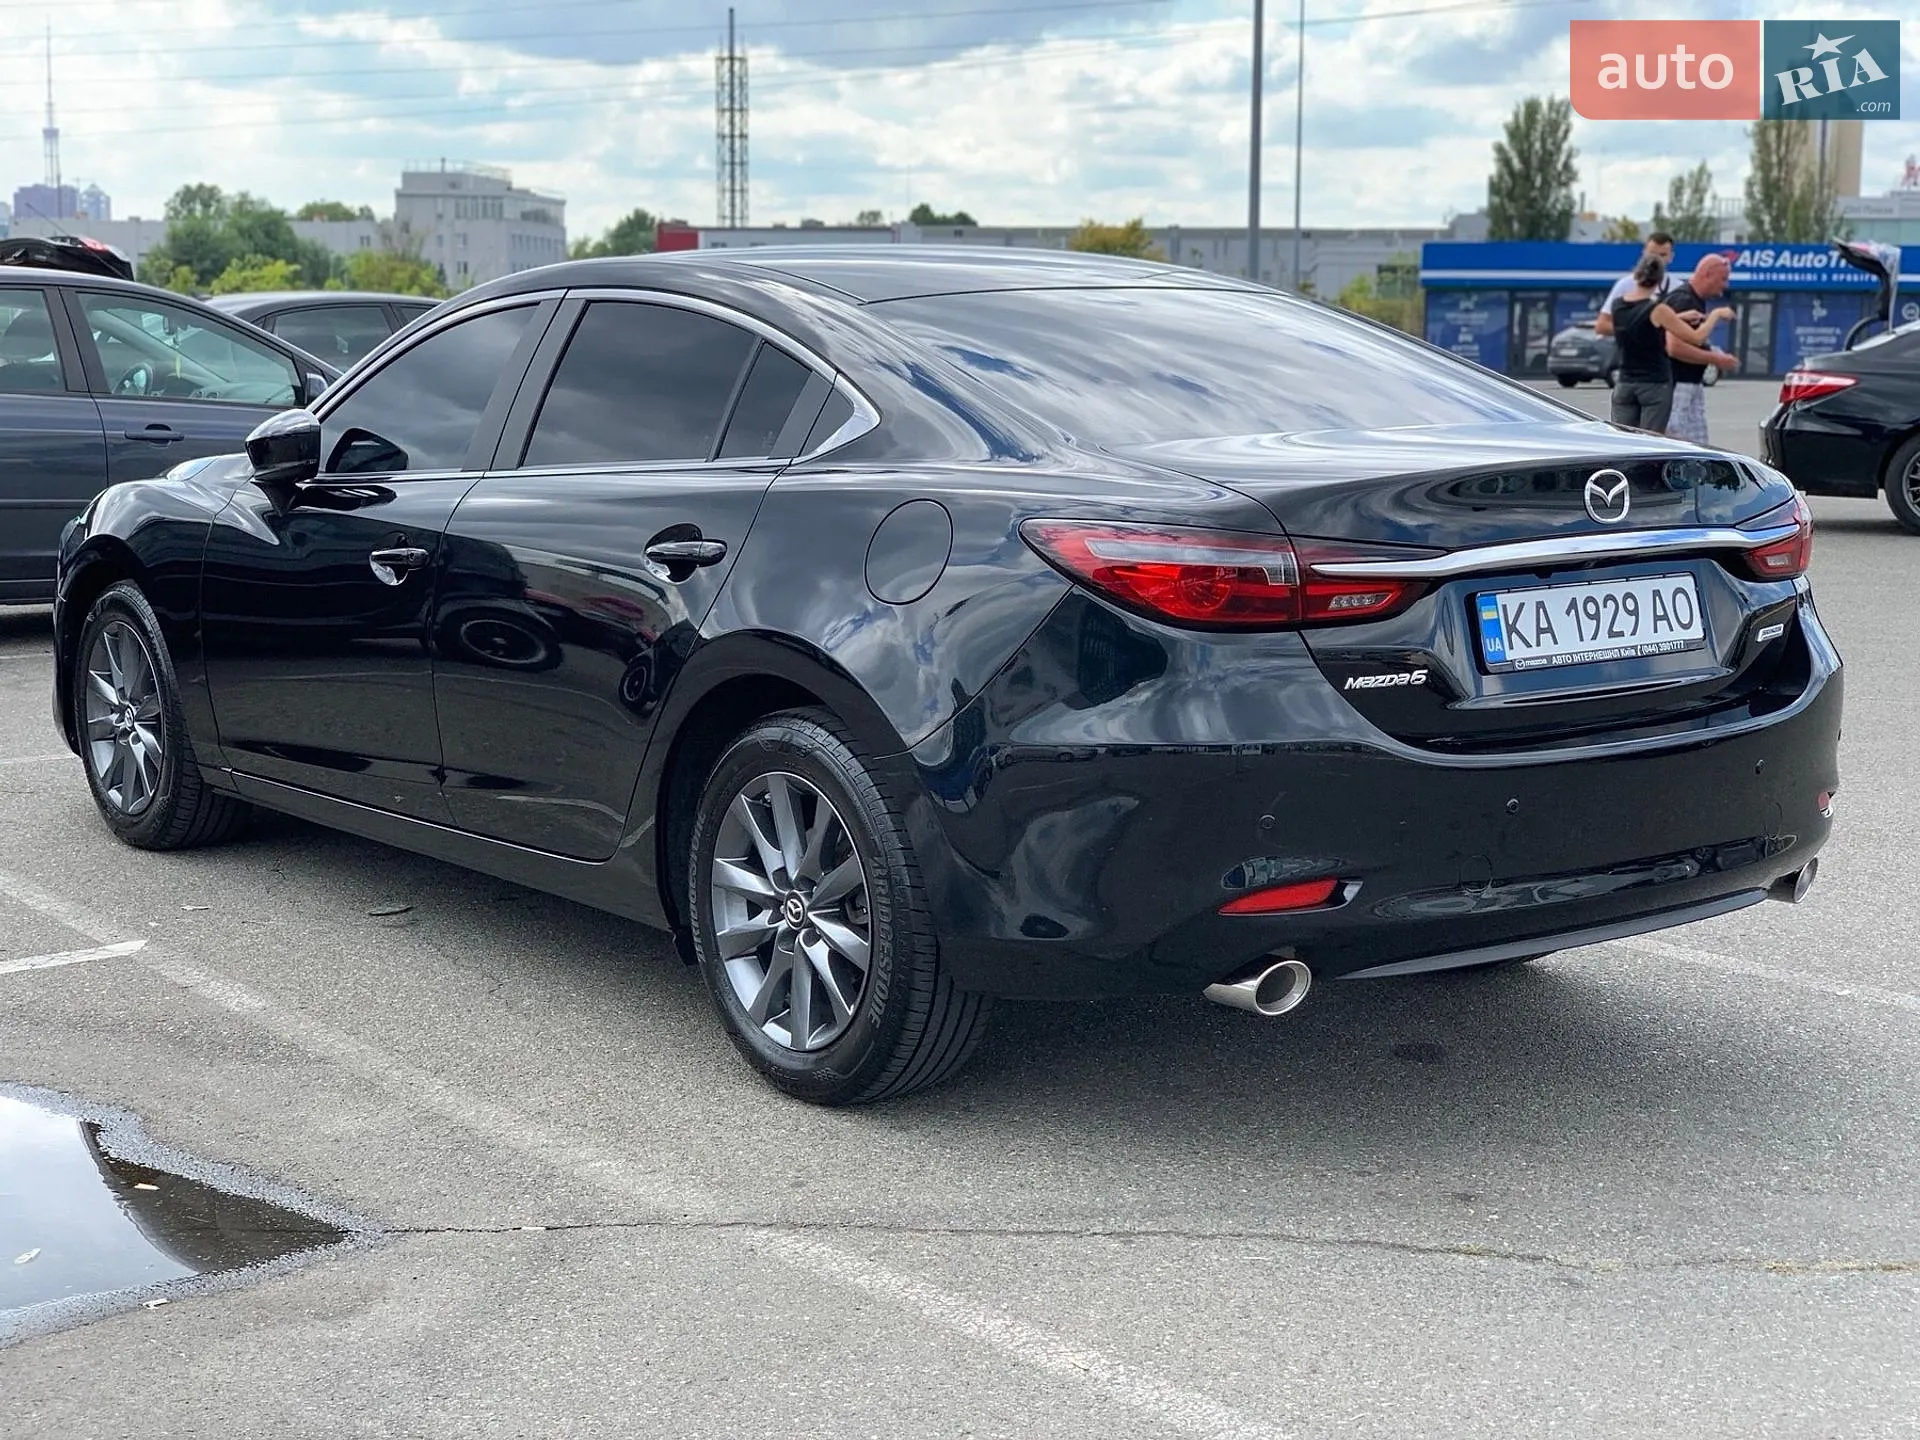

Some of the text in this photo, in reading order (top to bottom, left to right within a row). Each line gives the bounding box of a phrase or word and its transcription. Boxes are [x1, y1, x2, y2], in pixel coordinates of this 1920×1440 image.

[1735, 250, 1853, 268] AIS AutoTr
[1502, 587, 1694, 650] KA 1929 AO
[1487, 639, 1503, 652] UA
[1552, 653, 1572, 665] АВТО
